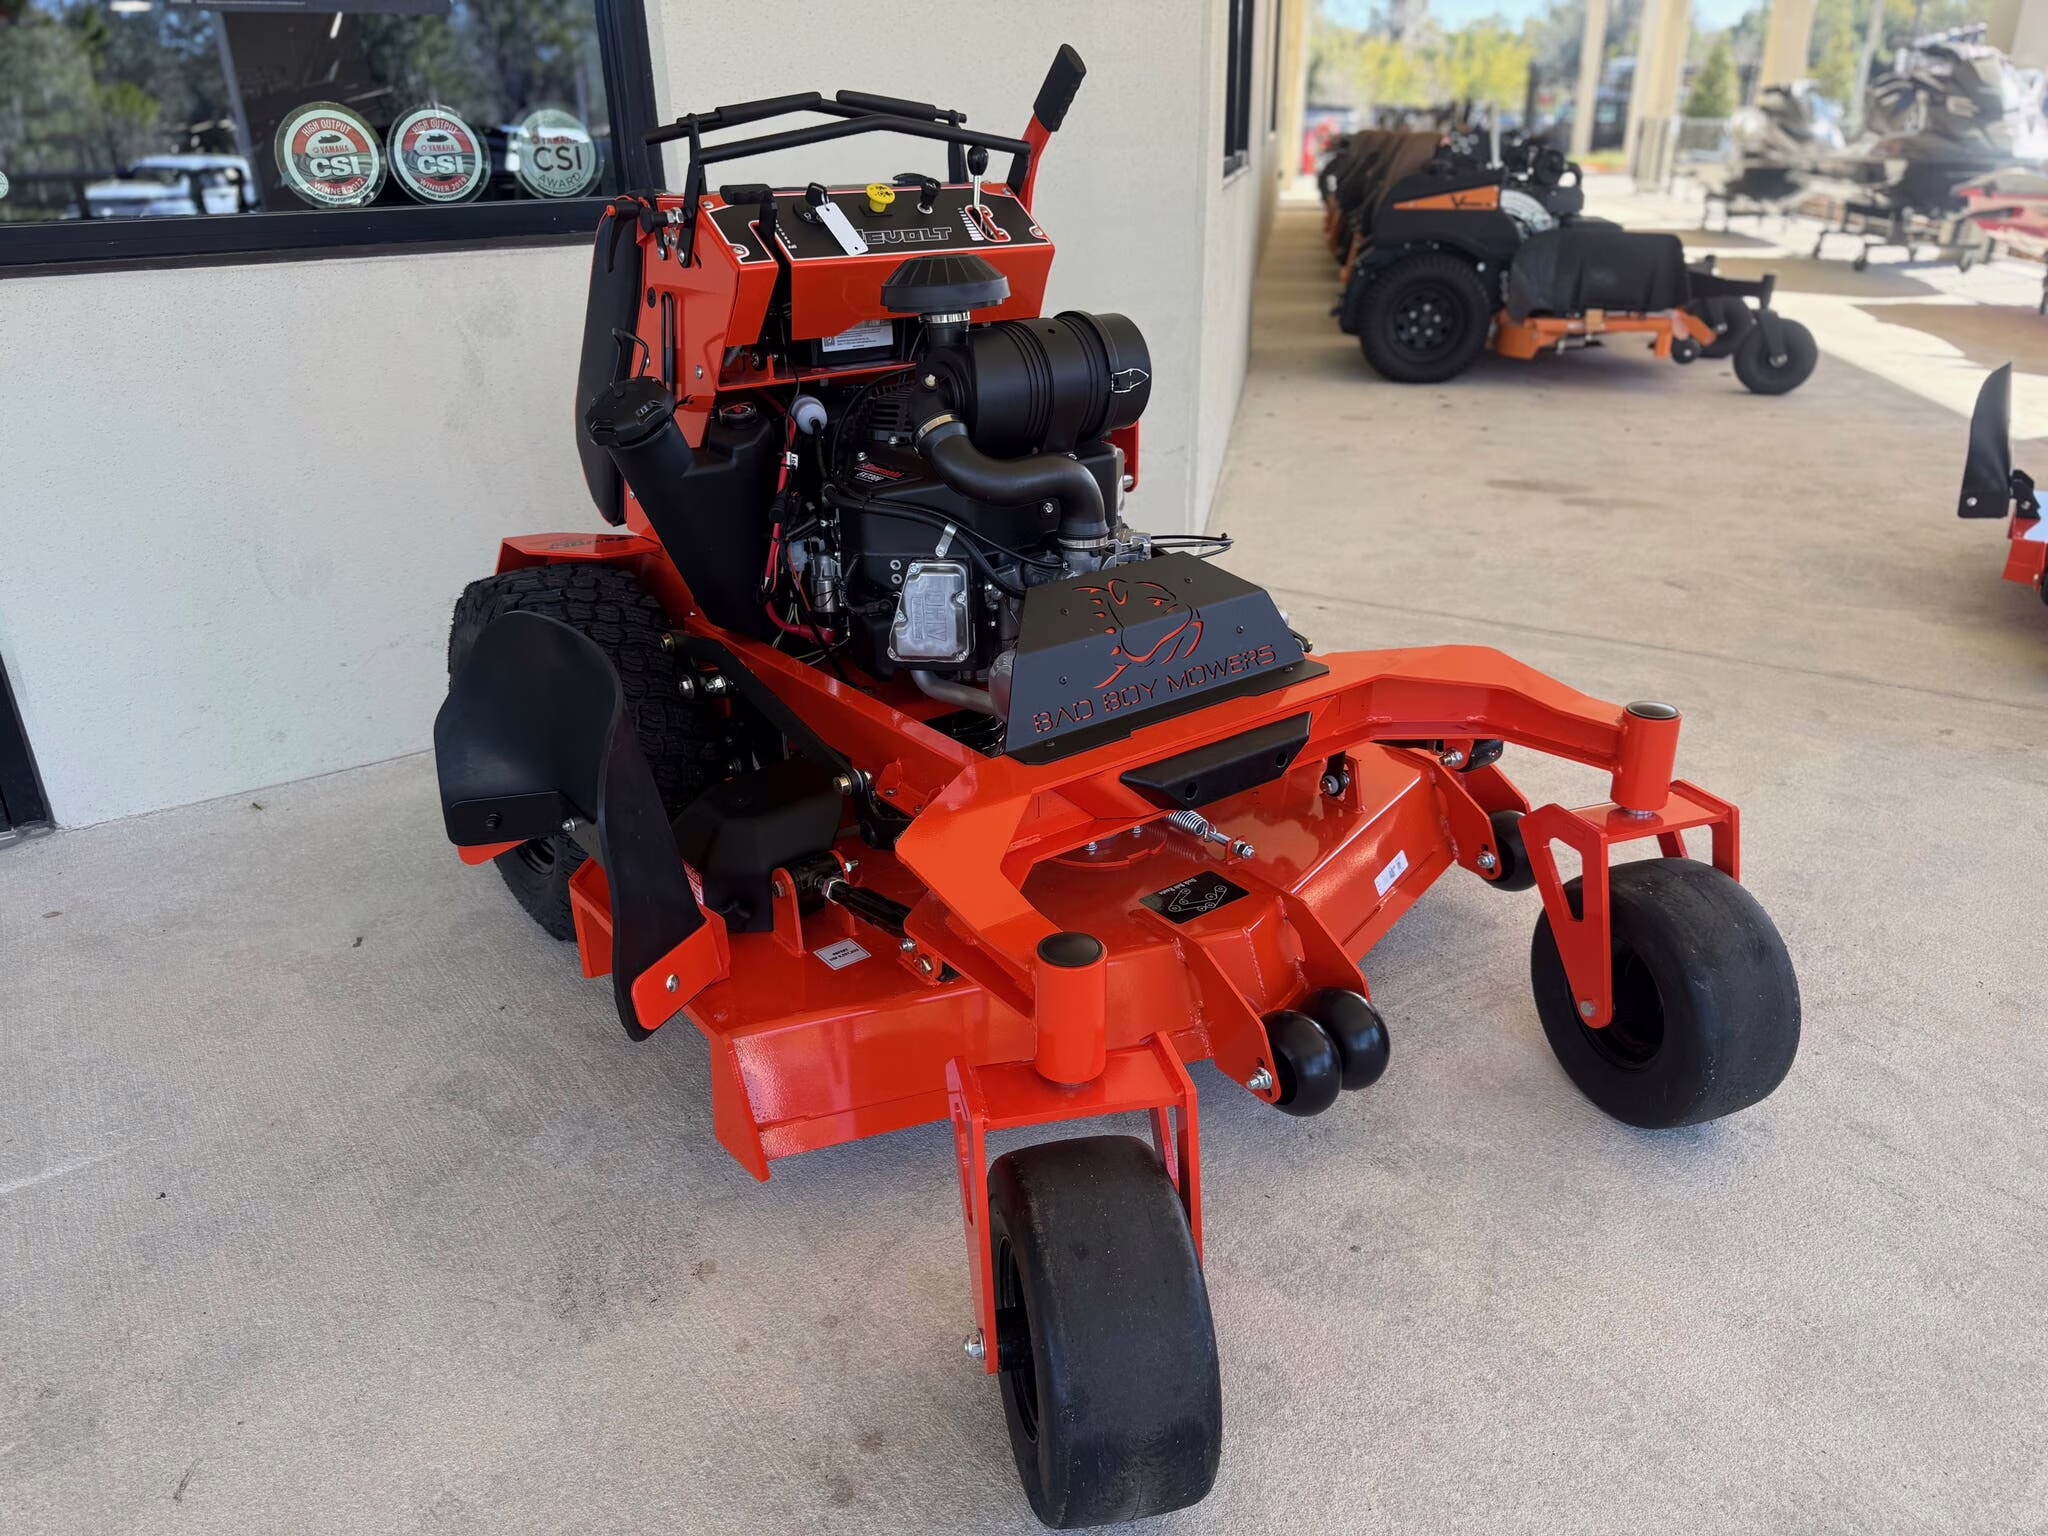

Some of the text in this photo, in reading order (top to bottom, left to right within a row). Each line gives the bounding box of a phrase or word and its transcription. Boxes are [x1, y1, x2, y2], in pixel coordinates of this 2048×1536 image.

[301, 119, 353, 137] HIGH OUTPUT
[411, 119, 459, 135] HIGH OUTPUT
[320, 145, 350, 154] YAMAHA
[428, 144, 456, 152] YAMAHA
[310, 156, 361, 177] CSI
[417, 155, 465, 174] CSI
[533, 145, 582, 171] CSI
[314, 178, 365, 195] WINNER 2012
[420, 178, 450, 192] WINNER
[538, 172, 581, 187] AWARD
[856, 227, 952, 244] EVOLT
[1033, 644, 1277, 734] BAD BOY MOWERS
